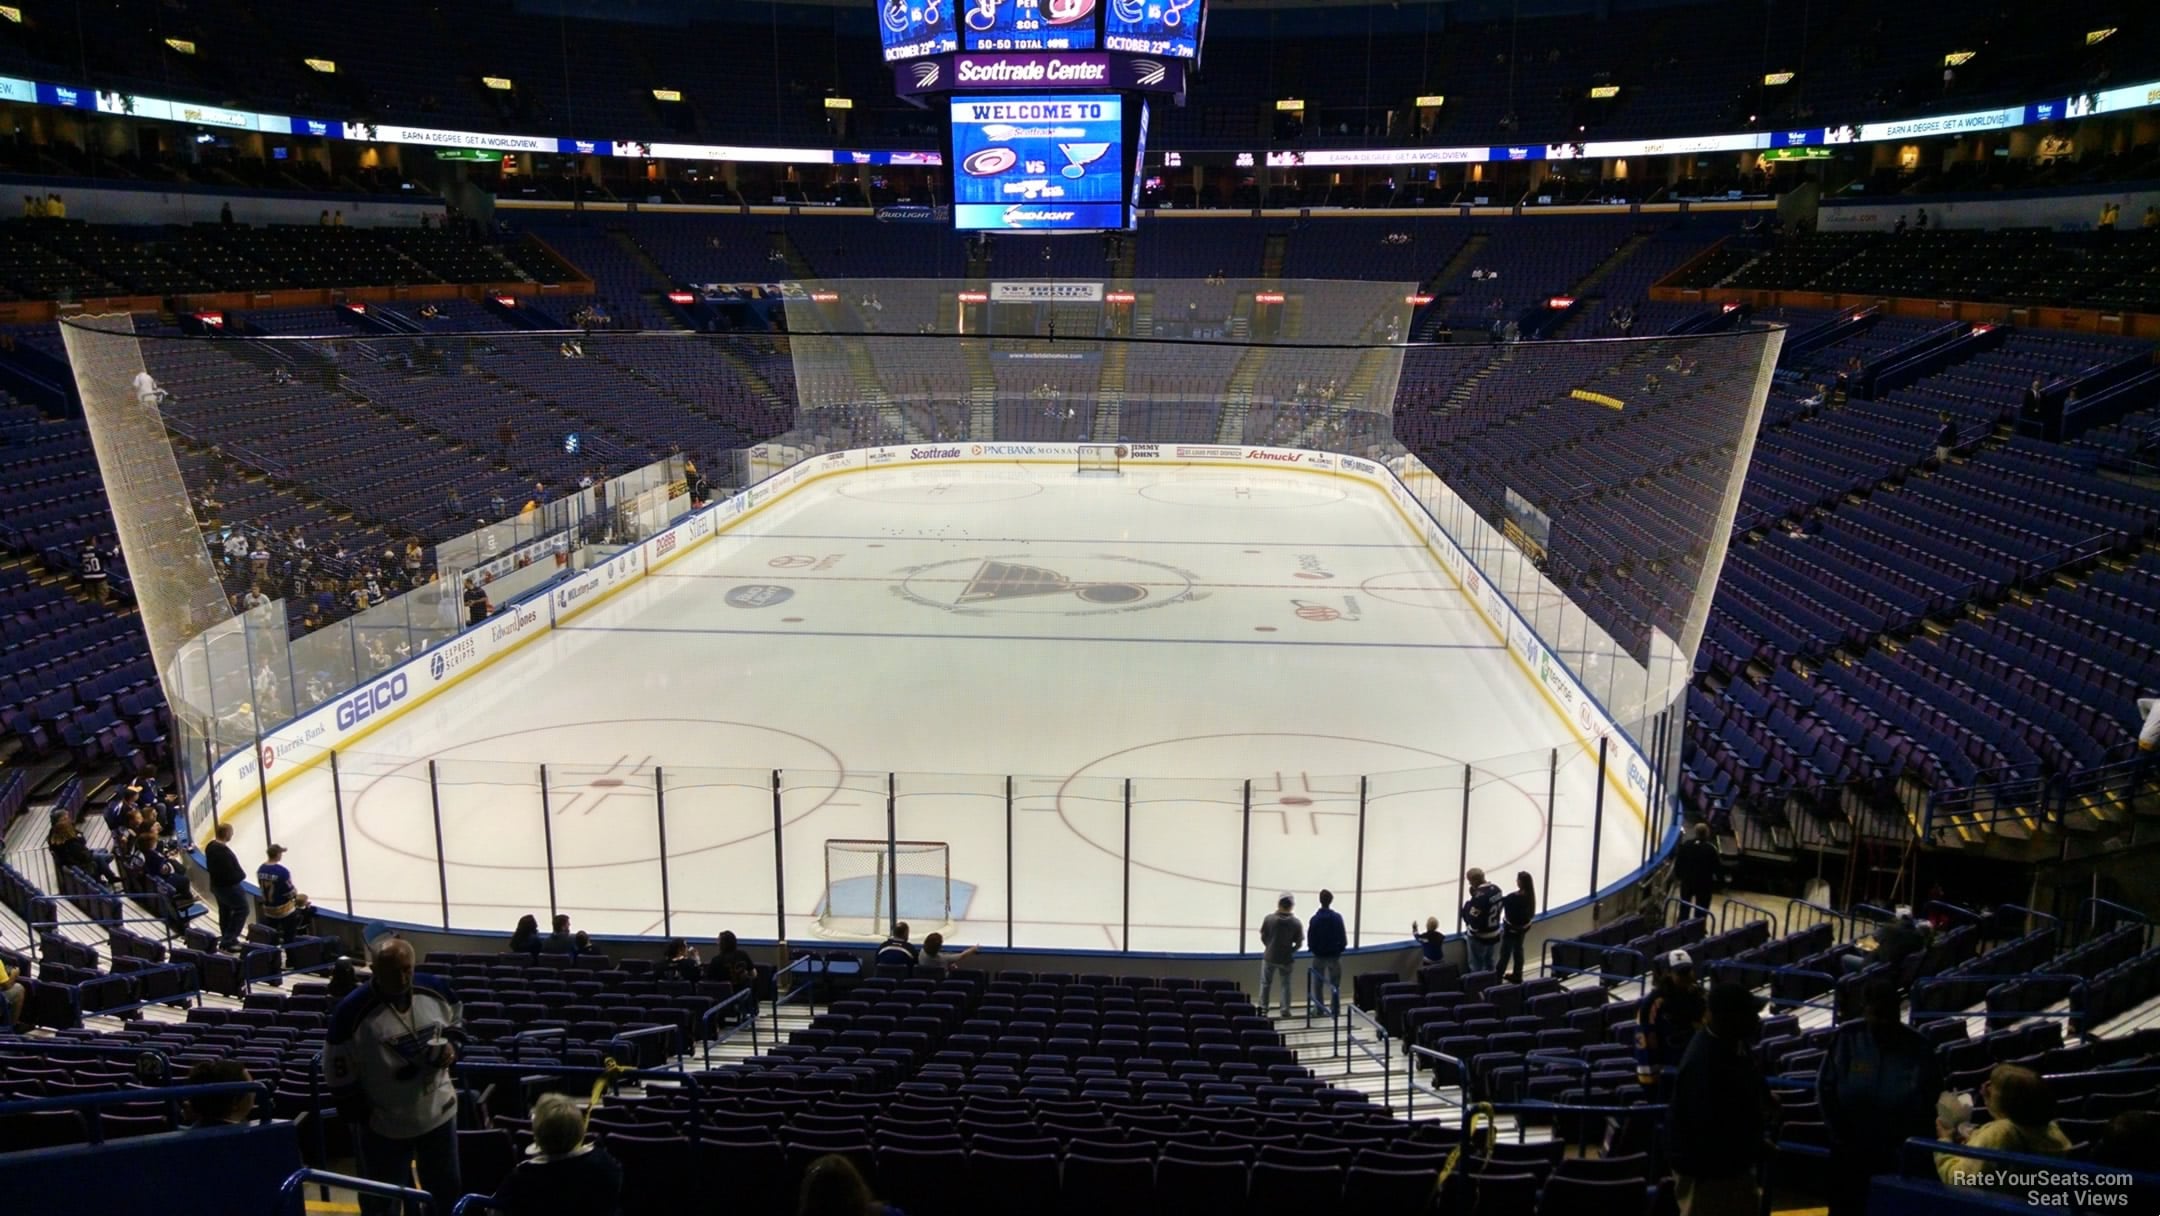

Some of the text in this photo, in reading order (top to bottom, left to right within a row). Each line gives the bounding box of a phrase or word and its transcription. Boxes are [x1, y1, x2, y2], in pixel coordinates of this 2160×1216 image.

[978, 39, 1011, 49] 50-50
[1014, 39, 1042, 49] TOTAL
[1106, 35, 1150, 54] OCTOBER
[958, 59, 1106, 81] Scottrade Center
[972, 103, 1102, 120] WELCOME TO
[1887, 126, 1906, 136] EARN
[1943, 119, 1957, 130] GET
[402, 130, 424, 141] EARN
[465, 135, 479, 144] GET
[1025, 160, 1046, 174] VS
[910, 447, 961, 460] Scottrade
[1246, 449, 1304, 462] Schnucks
[444, 636, 475, 660] EXPRESS
[446, 647, 476, 671] SCRIPTS
[336, 672, 409, 731] GEICO
[238, 722, 326, 780] BMO Harris Bank
